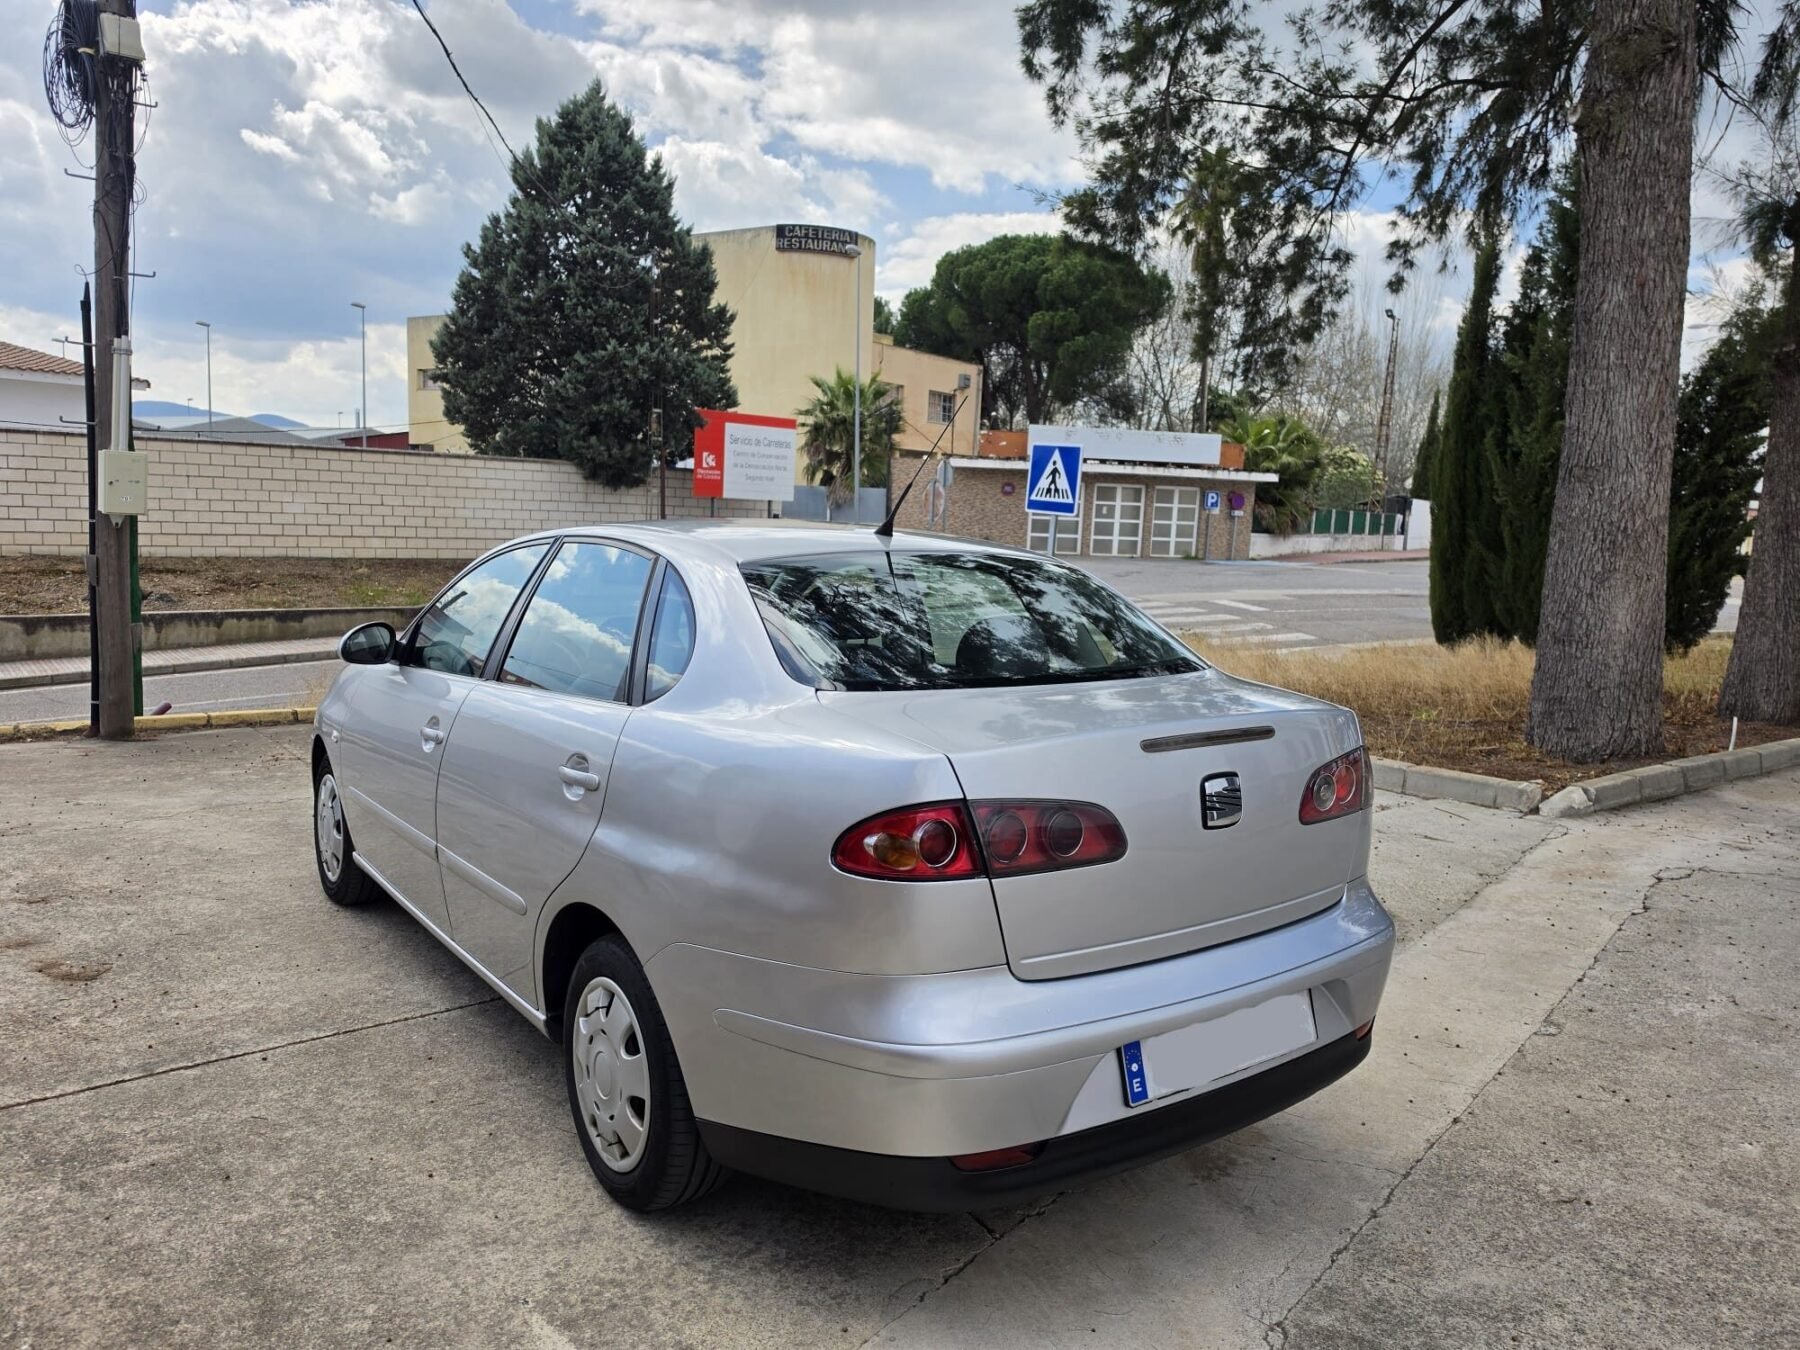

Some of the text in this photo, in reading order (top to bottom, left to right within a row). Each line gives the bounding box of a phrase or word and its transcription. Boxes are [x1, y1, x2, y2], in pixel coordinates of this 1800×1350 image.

[785, 226, 851, 242] CAFETERIA
[729, 434, 753, 446] Servicio
[754, 437, 761, 446] de
[1207, 492, 1218, 507] P
[1133, 1078, 1142, 1093] E
